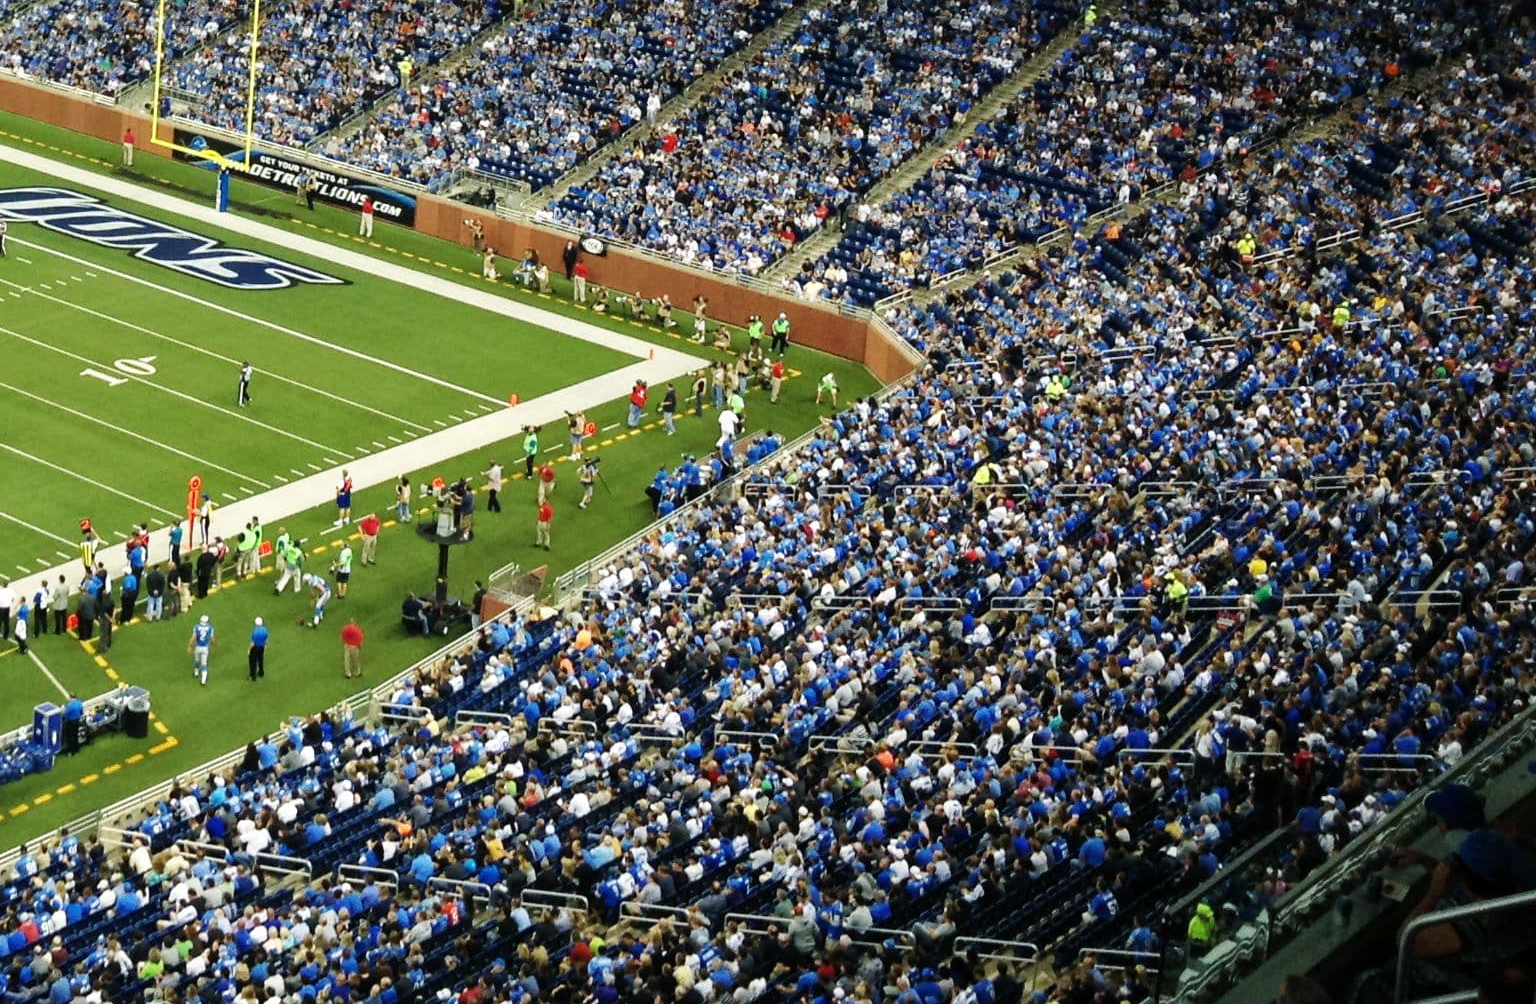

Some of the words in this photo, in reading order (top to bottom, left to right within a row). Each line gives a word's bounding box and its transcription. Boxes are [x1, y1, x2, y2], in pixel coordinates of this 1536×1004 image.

[260, 155, 276, 165] GET
[278, 160, 300, 172] YOUR
[337, 178, 349, 186] AT
[80, 356, 156, 387] 10
